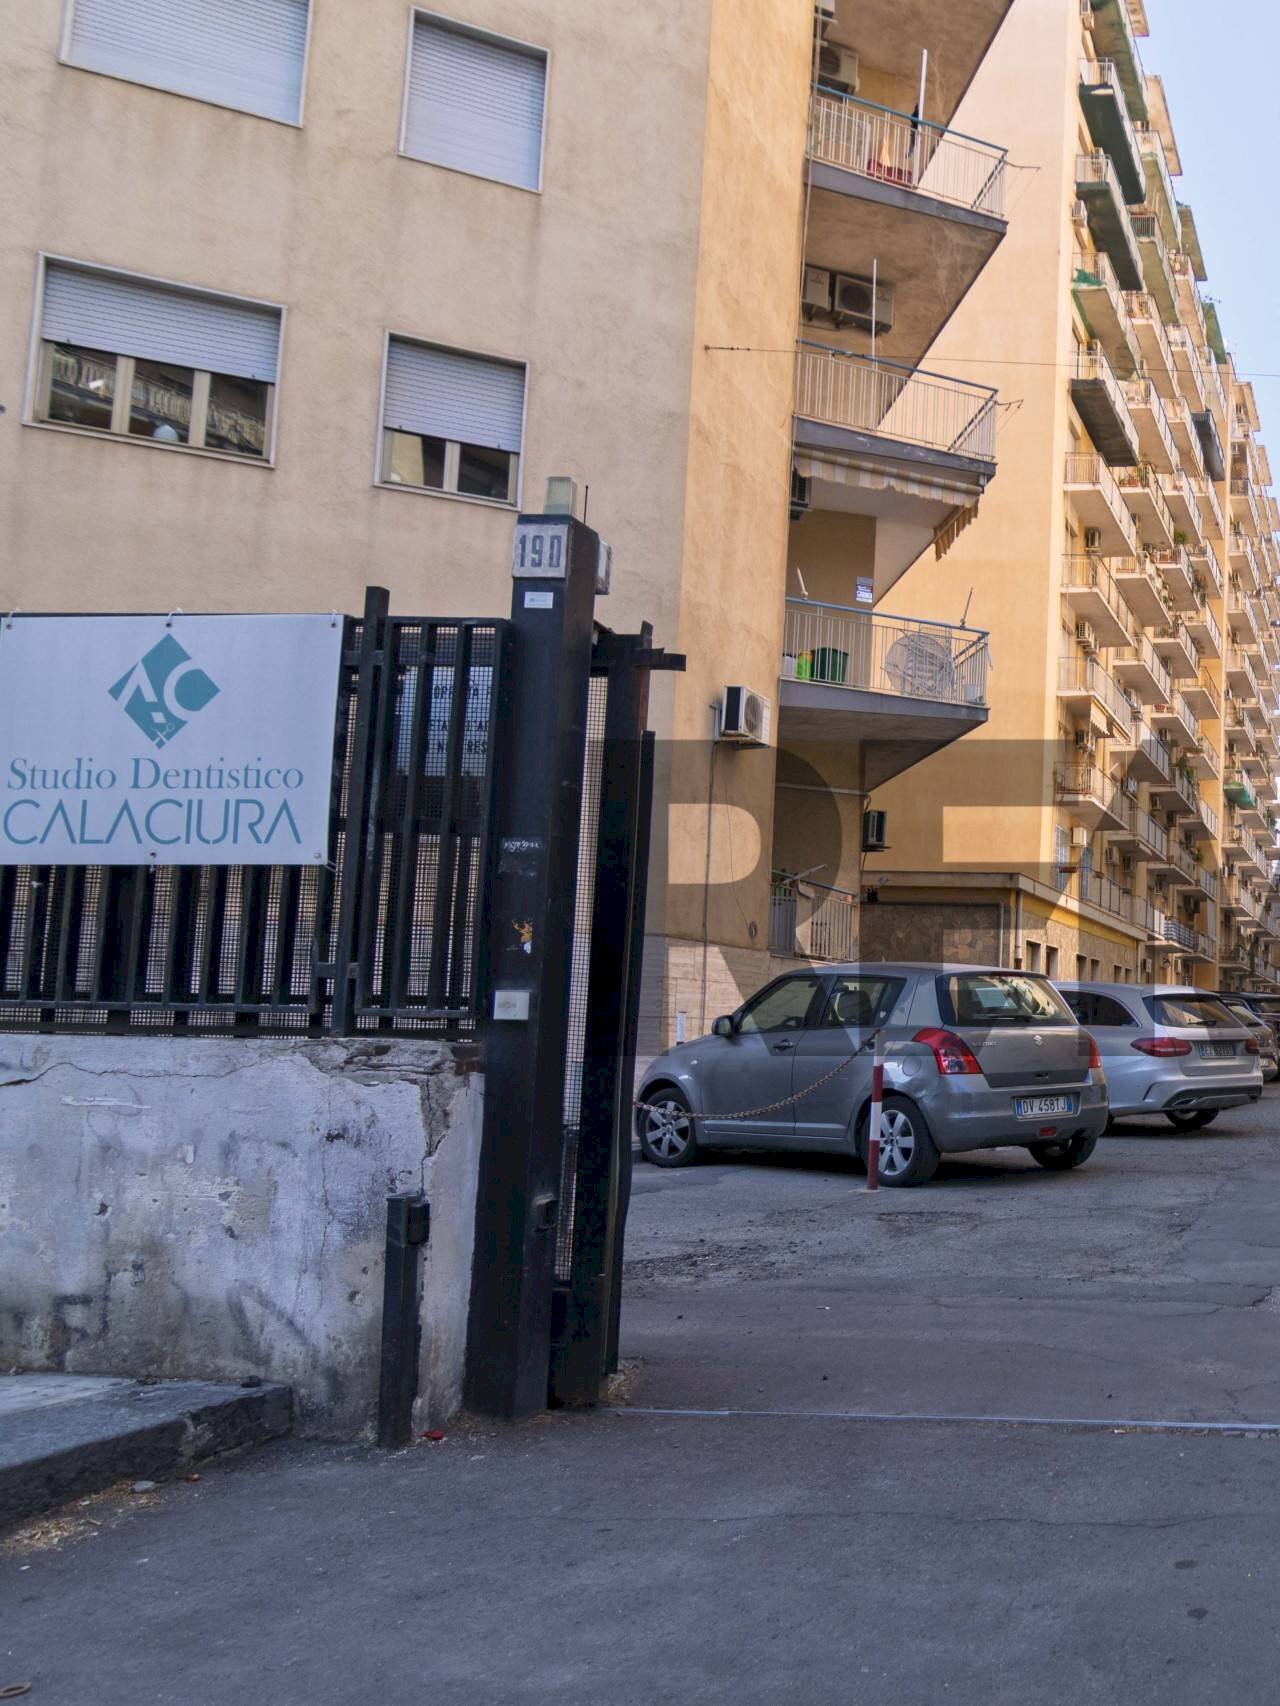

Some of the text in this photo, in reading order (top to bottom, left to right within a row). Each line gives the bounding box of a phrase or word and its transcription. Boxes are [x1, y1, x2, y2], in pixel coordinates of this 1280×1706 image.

[519, 534, 562, 569] 190
[7, 756, 304, 790] Studio Dentistico
[3, 798, 303, 846] CALACIURA
[1038, 1096, 1066, 1112] 458TJ
